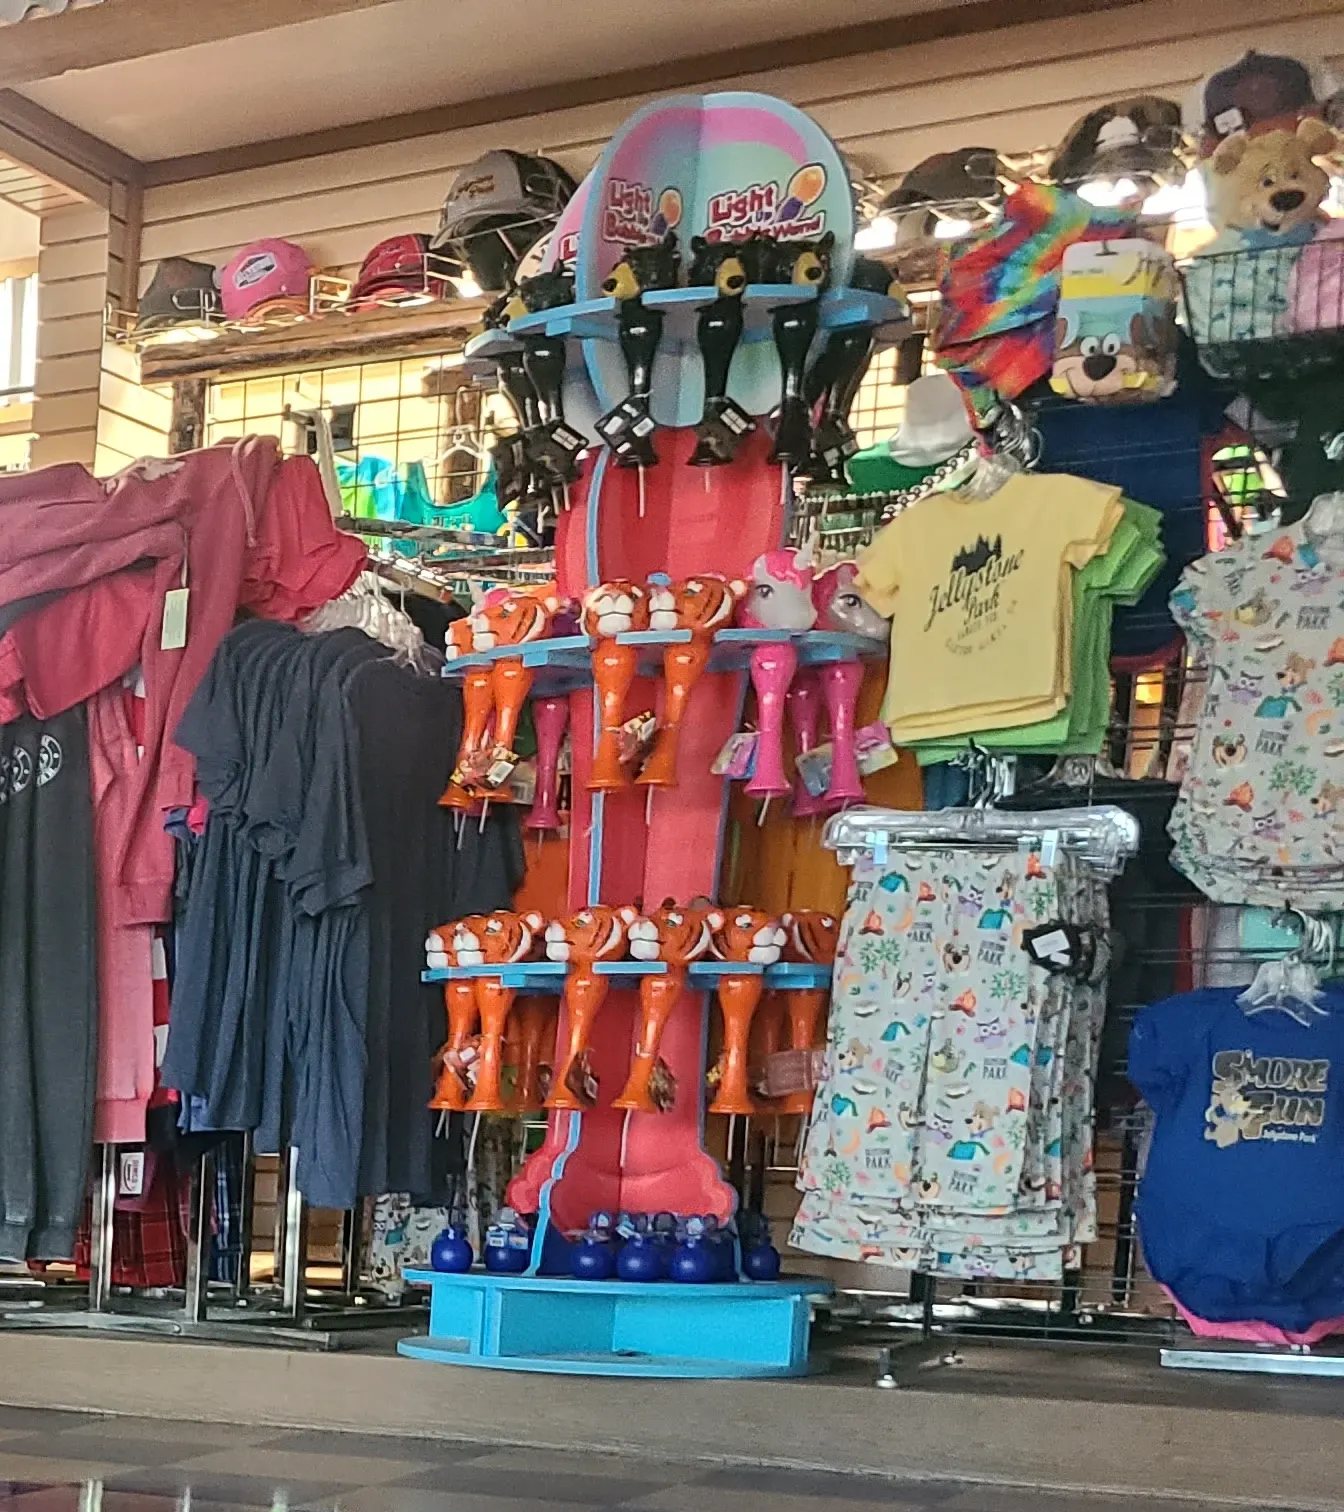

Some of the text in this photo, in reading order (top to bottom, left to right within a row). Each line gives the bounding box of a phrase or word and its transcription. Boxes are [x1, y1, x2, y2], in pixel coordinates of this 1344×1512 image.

[711, 185, 774, 224] Light
[923, 549, 1024, 633] Jellystone
[1212, 1049, 1329, 1092] S'MORE
[1241, 1090, 1325, 1140] FUN
